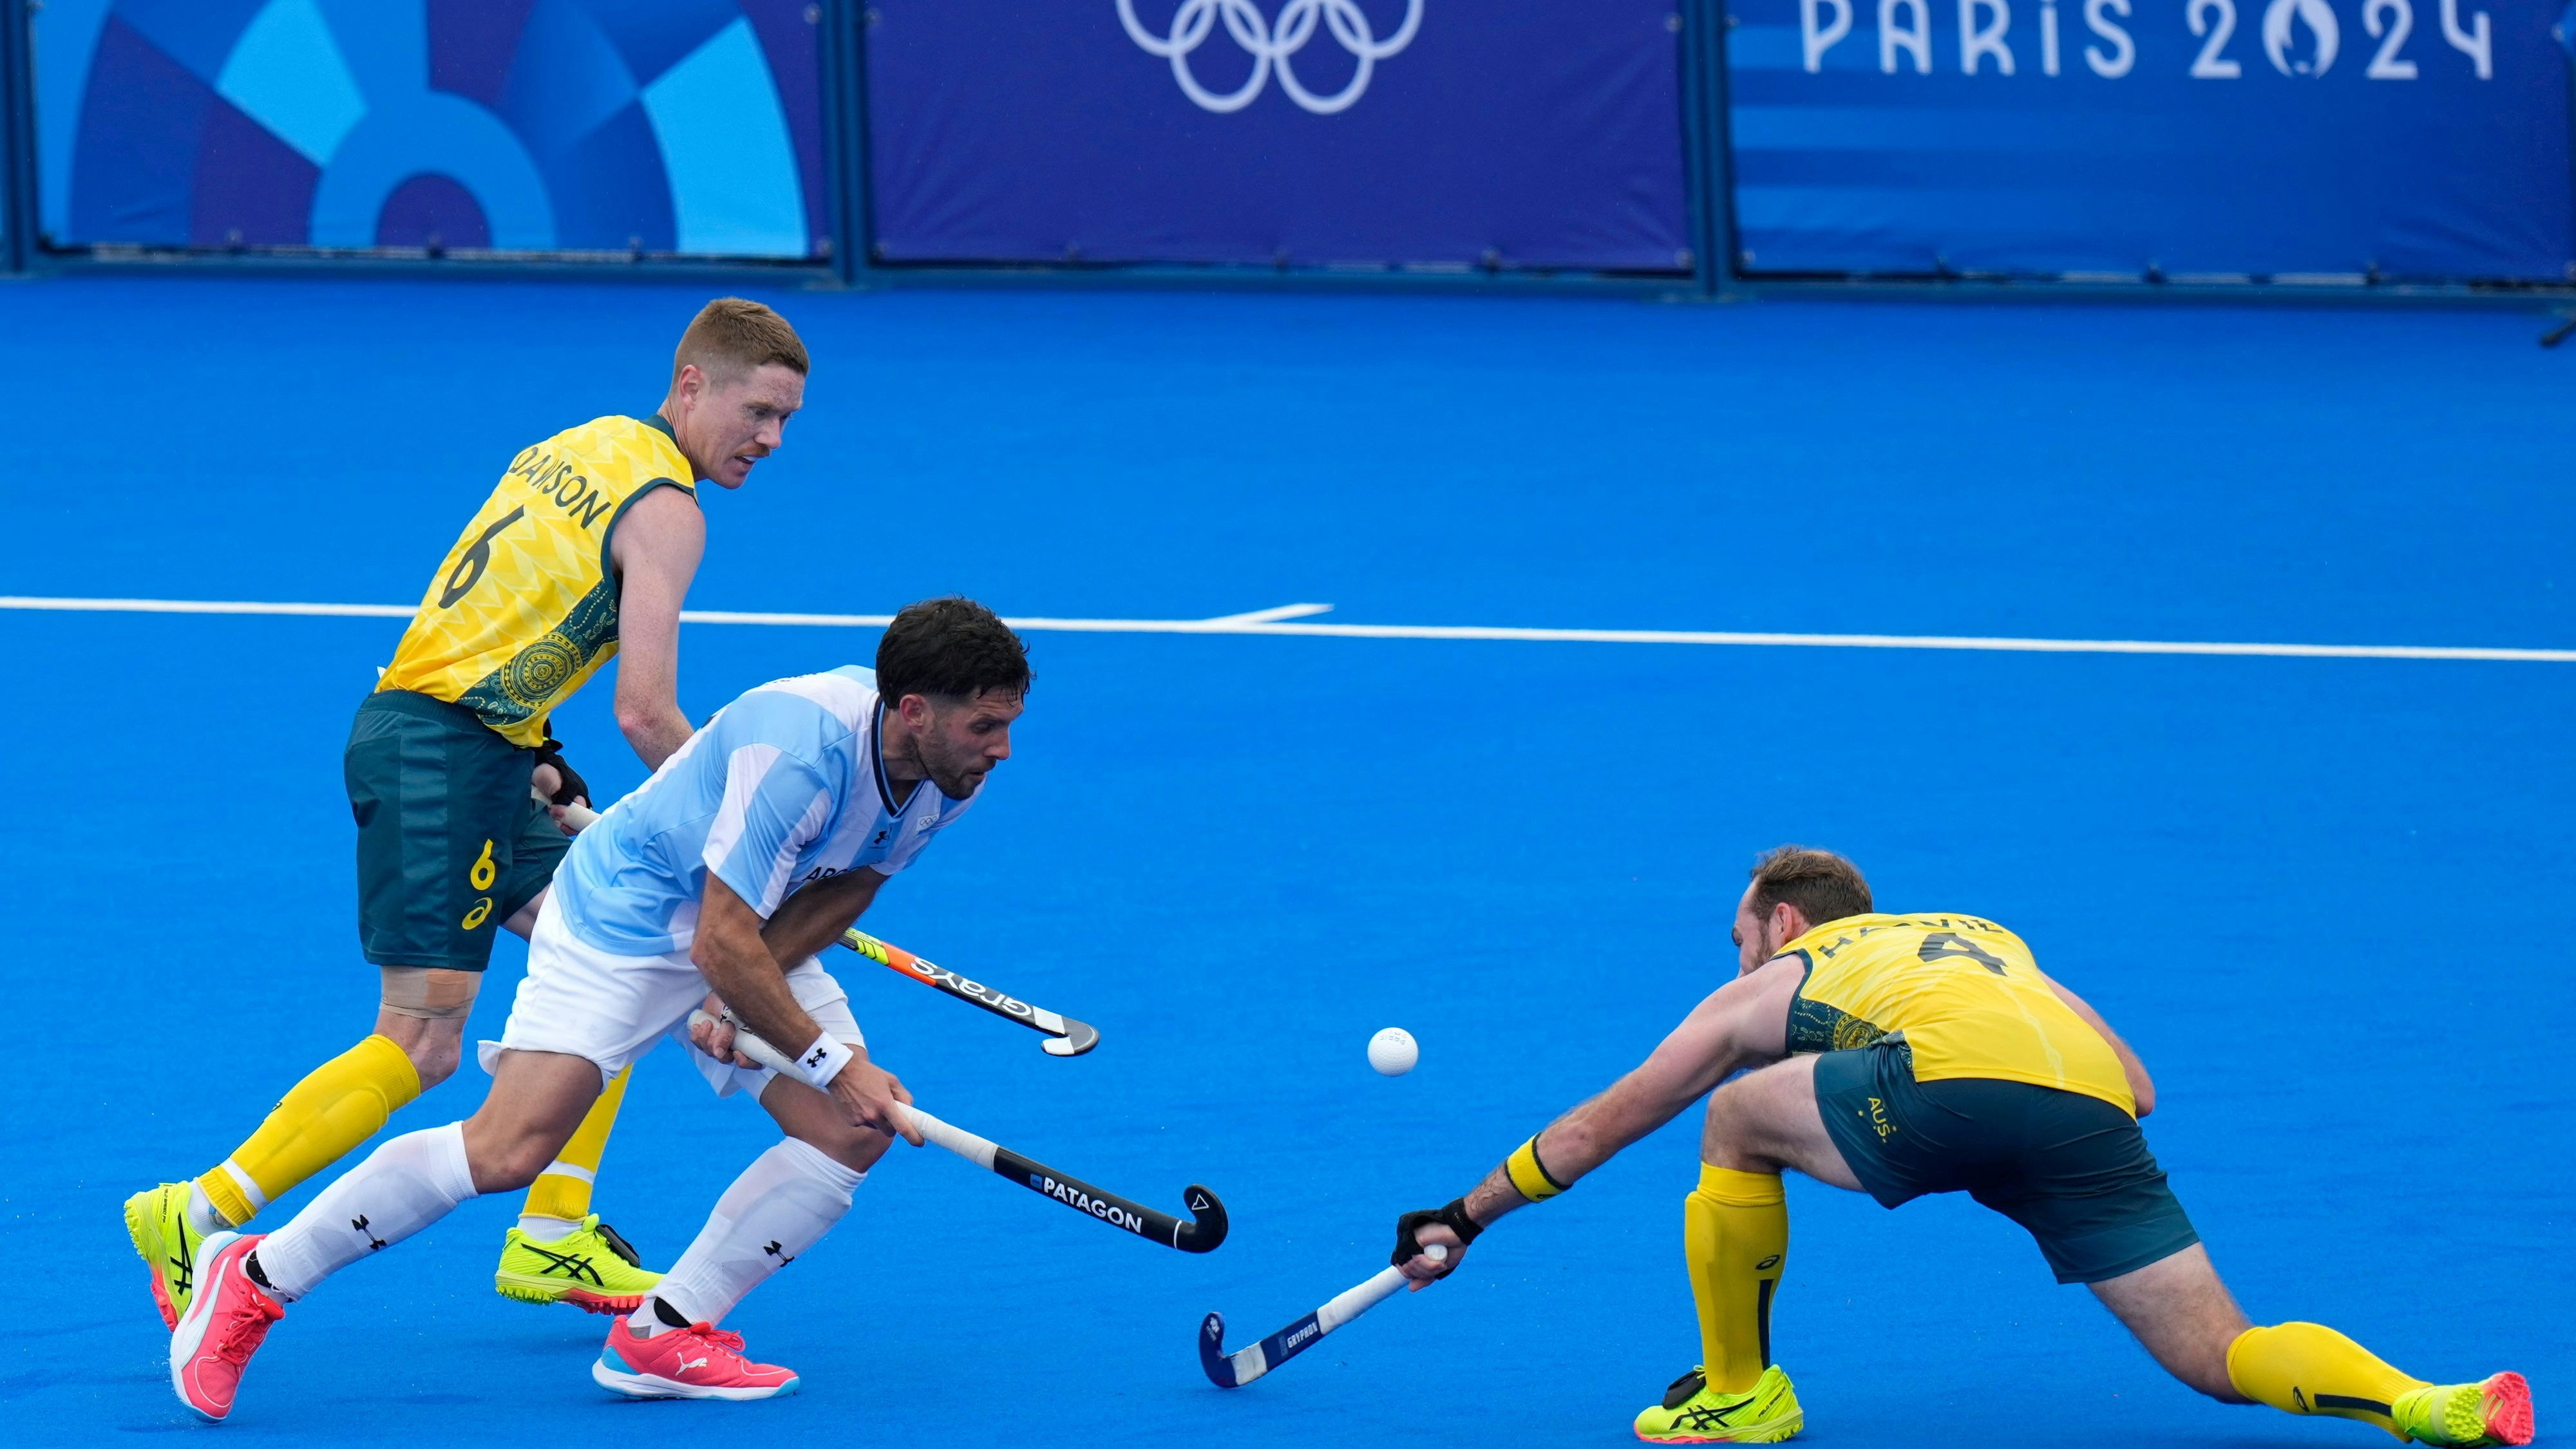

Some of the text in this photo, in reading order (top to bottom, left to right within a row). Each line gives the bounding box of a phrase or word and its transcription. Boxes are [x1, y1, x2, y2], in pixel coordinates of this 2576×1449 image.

[508, 446, 612, 530] DAWSON
[438, 504, 524, 609] 6
[470, 838, 496, 891] 6
[1917, 932, 2008, 977] 4
[1868, 1097, 1891, 1137] AUS
[1044, 1177, 1142, 1240] PATAGON
[1287, 1321, 1318, 1349] GRYPHON
